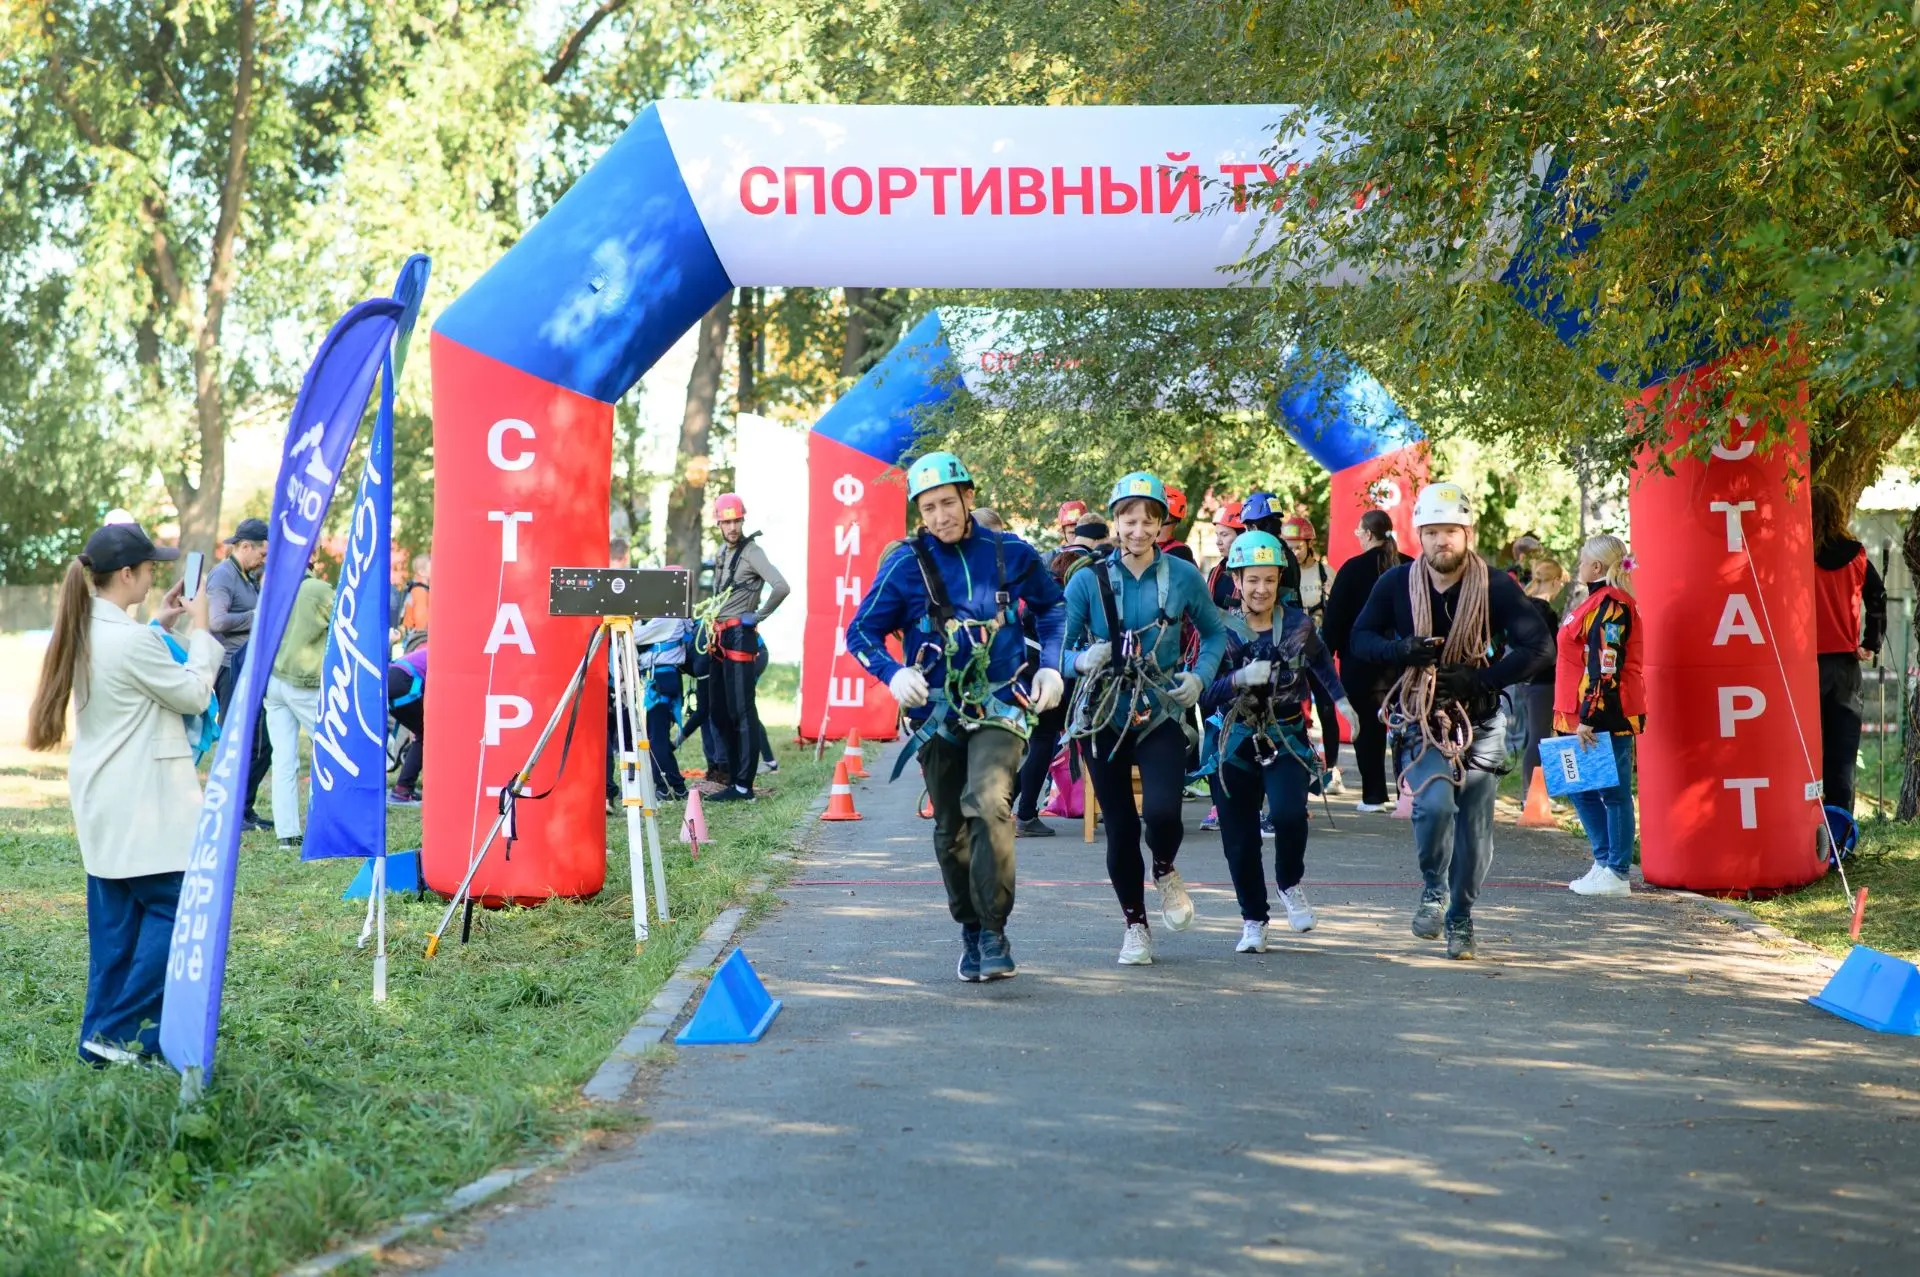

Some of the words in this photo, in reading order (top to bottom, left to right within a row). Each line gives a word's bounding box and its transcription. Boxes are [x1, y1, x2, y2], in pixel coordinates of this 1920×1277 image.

[739, 151, 1201, 216] СПОРТИВНЫЙ
[482, 418, 537, 838] СТАРТ
[1709, 413, 1771, 830] СТАРТ
[1563, 753, 1576, 780] СТАРТ
